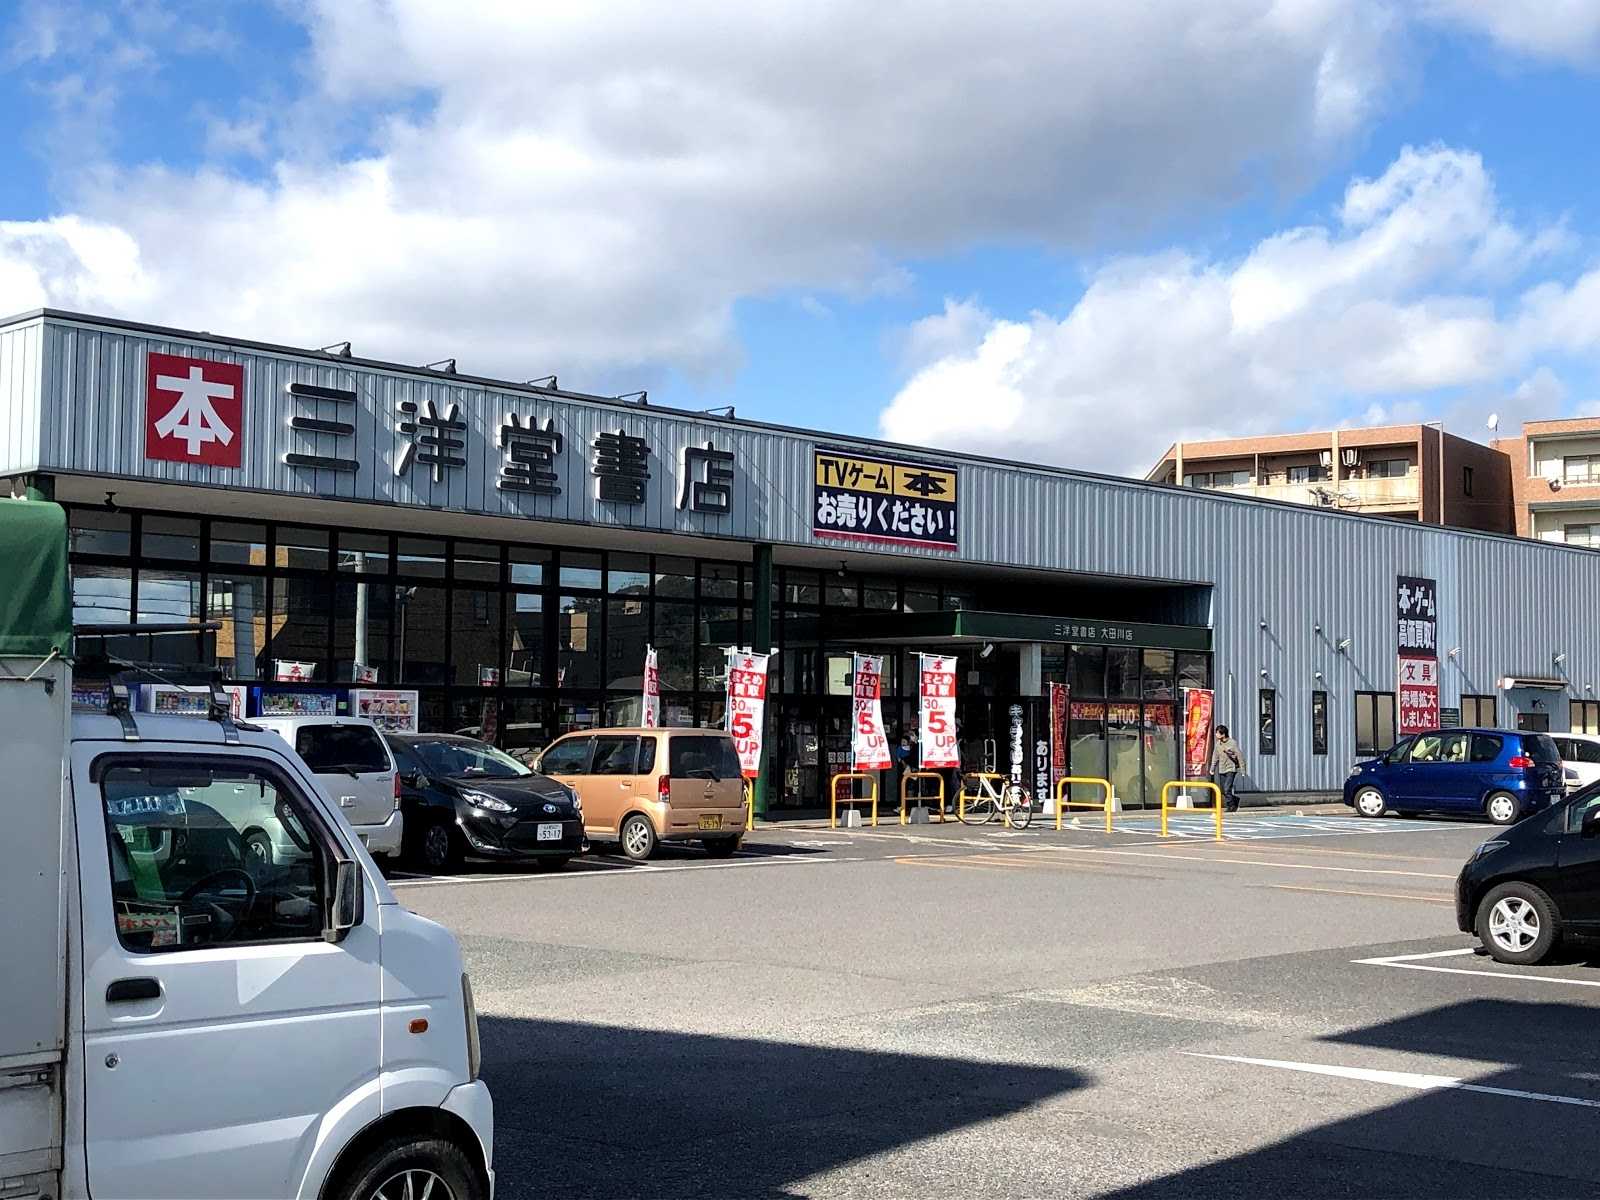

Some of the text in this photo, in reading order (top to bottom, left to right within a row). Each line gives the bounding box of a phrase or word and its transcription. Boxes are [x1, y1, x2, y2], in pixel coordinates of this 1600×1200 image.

[154, 366, 235, 456] 本
[282, 382, 735, 513] 三洋堂書店
[819, 458, 889, 491] TVゲーム
[903, 471, 948, 497] 本
[817, 491, 956, 537] お売りください！
[1053, 624, 1134, 641] 三洋堂書店 大田川店
[1406, 663, 1431, 681] 文具
[928, 711, 948, 734] 5
[736, 740, 759, 754] UP
[867, 735, 885, 748] UP
[935, 735, 956, 748] UP
[1036, 739, 1049, 804] あります
